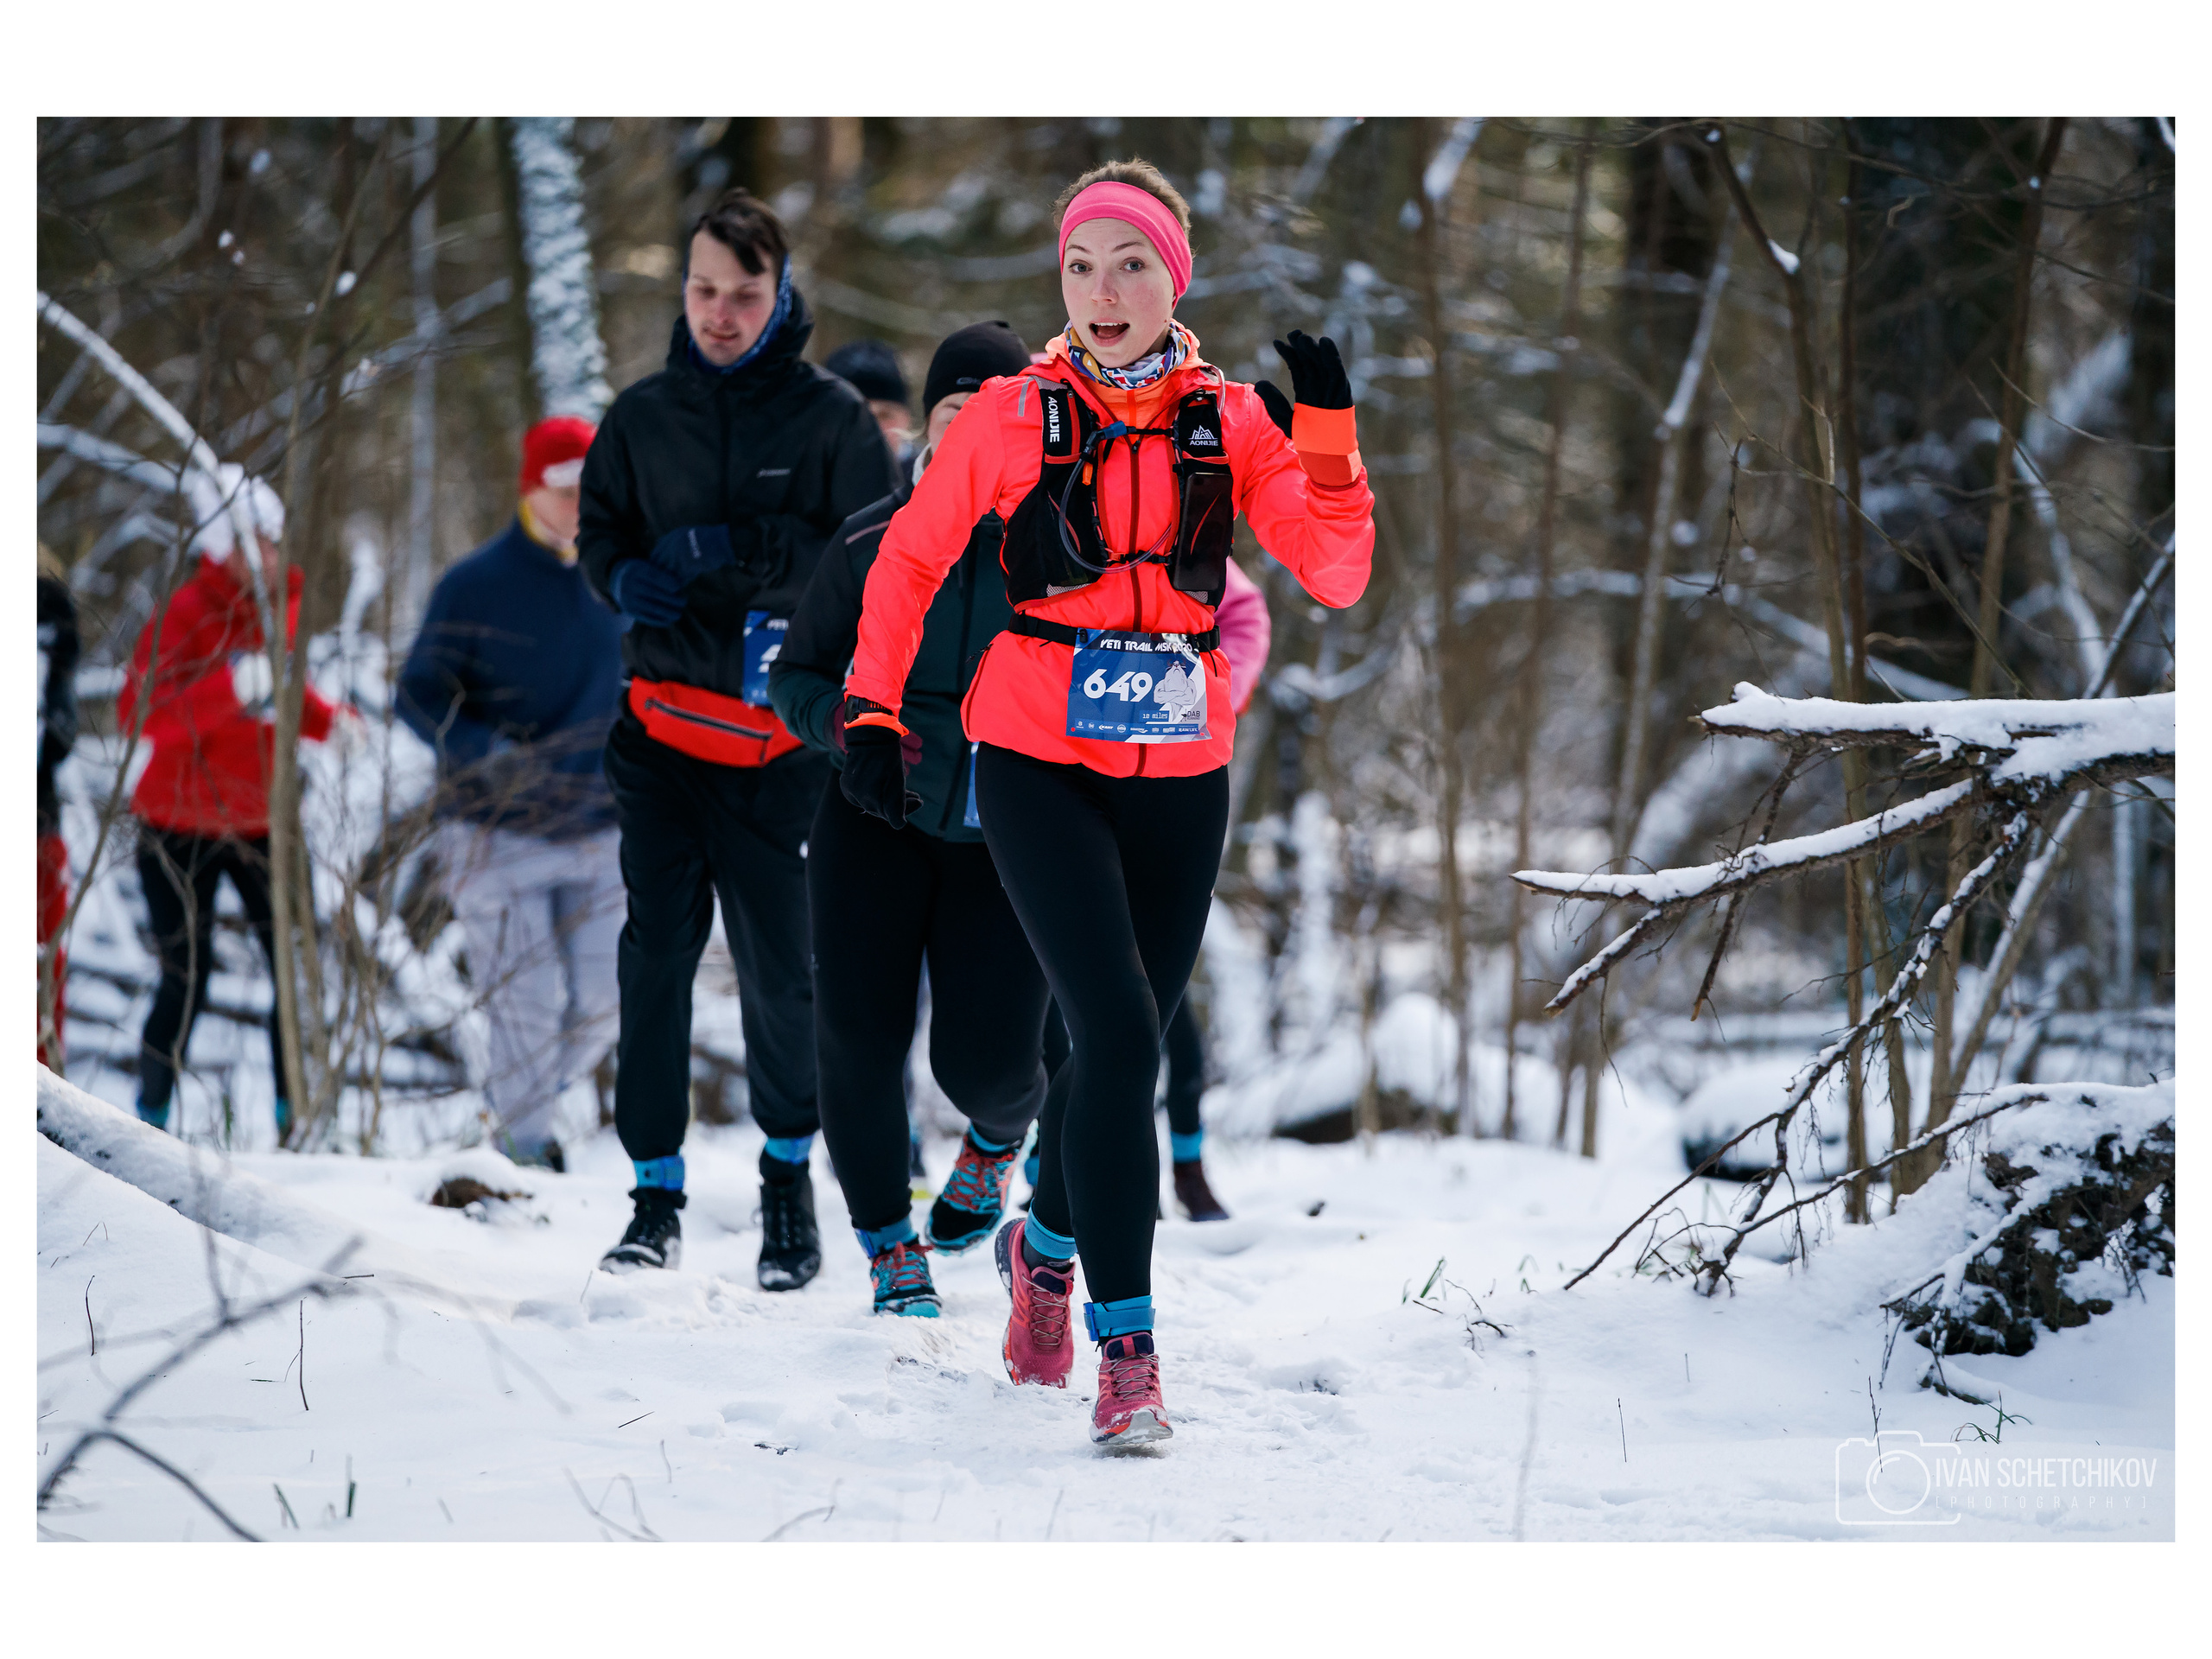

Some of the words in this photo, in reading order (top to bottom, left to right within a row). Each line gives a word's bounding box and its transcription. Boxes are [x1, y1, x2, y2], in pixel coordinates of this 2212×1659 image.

[1047, 396, 1060, 442] AONIJIE
[1100, 639, 1122, 650] YETI
[1124, 640, 1153, 652] TRAIL
[1084, 668, 1154, 702] 649
